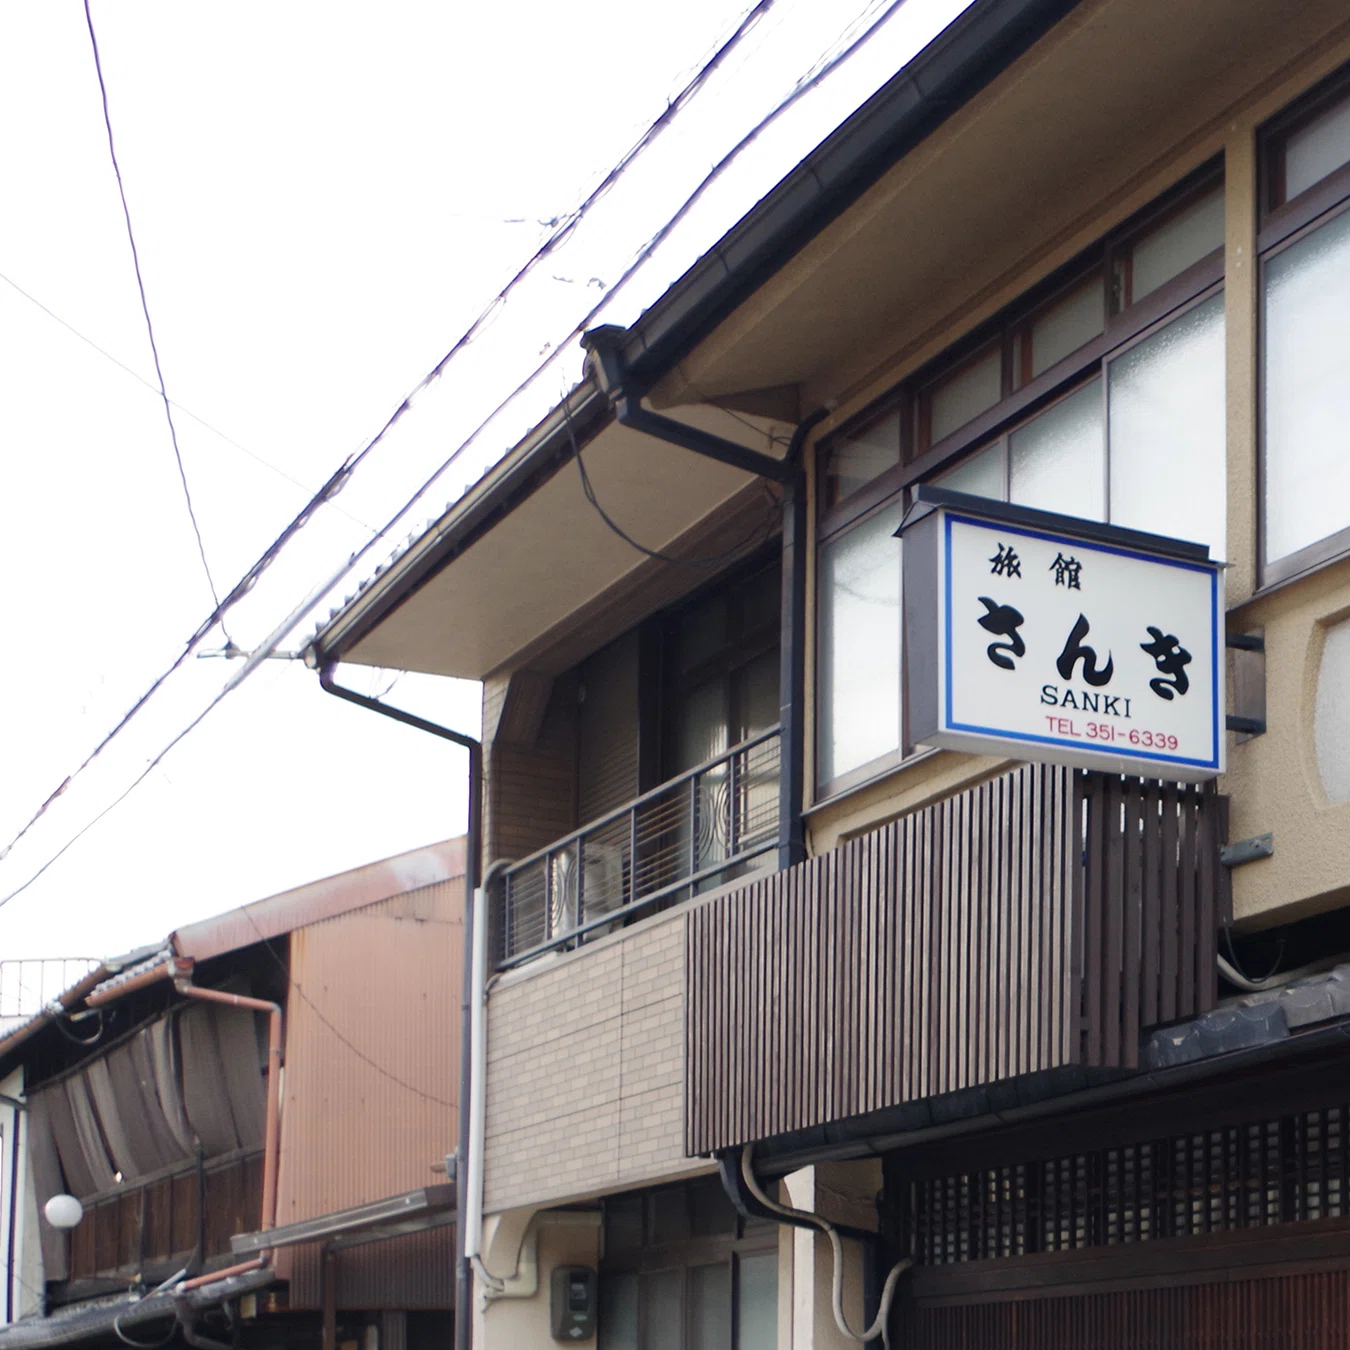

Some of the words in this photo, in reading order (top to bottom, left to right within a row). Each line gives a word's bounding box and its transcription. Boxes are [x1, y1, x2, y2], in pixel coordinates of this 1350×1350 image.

[987, 542, 1083, 591] 旅館
[976, 596, 1193, 701] さんき
[1040, 684, 1132, 719] SANKI
[1045, 716, 1082, 738] TEL
[1085, 722, 1179, 751] 351-6339
